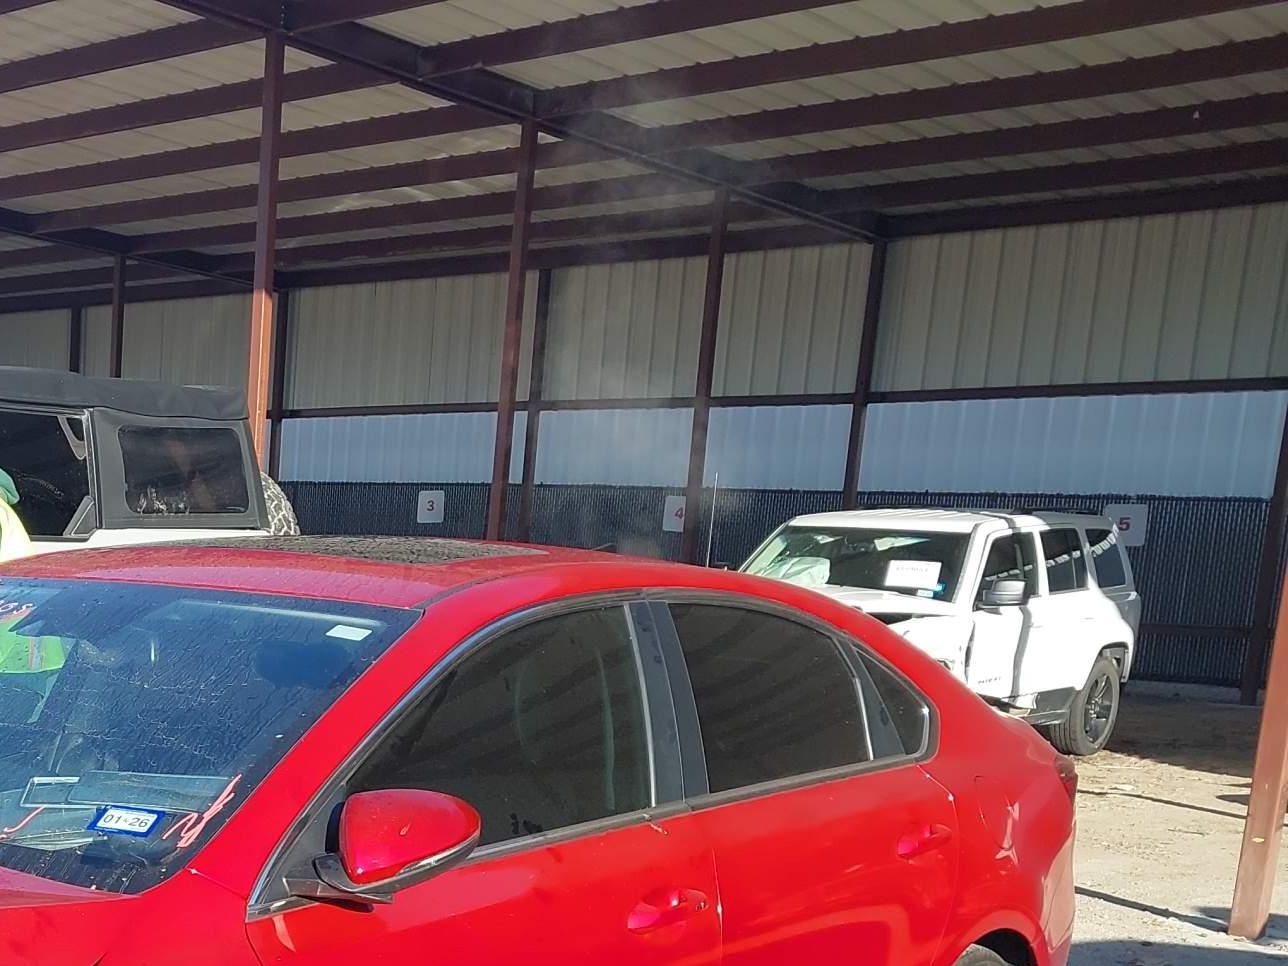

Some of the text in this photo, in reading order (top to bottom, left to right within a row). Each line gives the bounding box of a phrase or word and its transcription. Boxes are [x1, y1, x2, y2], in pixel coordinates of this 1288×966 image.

[426, 500, 435, 512] 3
[674, 506, 684, 519] 4
[1118, 516, 1131, 532] 5
